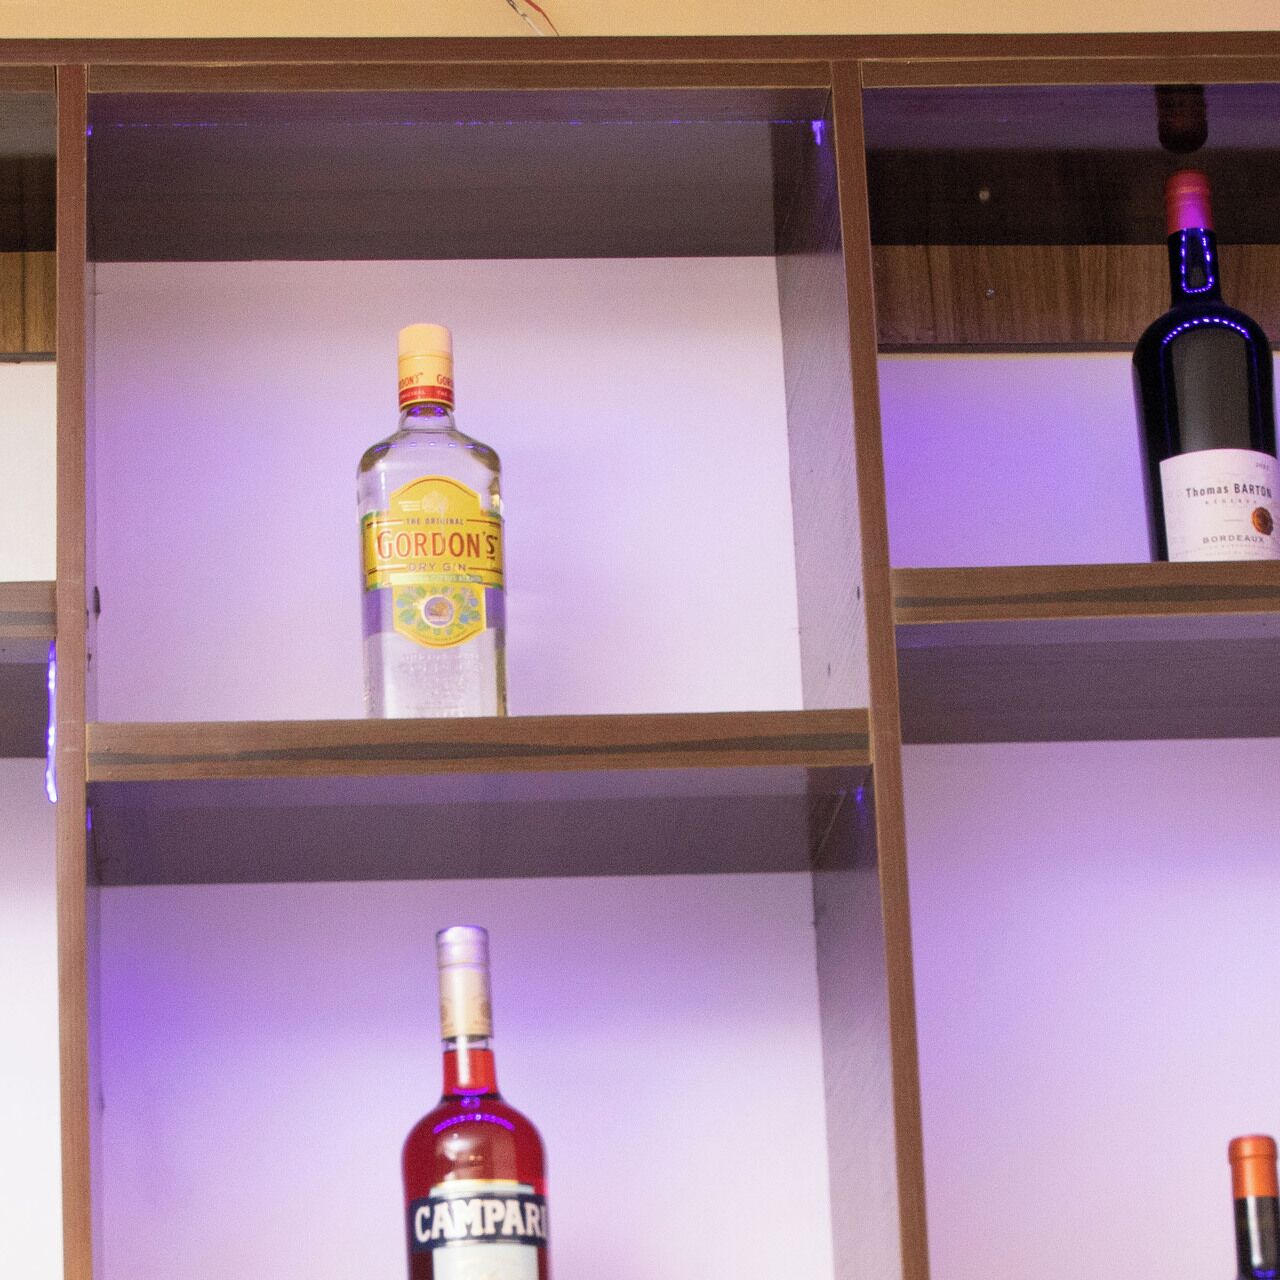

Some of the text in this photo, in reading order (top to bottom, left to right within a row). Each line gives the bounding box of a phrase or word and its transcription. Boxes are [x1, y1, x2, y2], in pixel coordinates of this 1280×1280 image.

[1186, 483, 1272, 498] Thomas BARTON
[376, 530, 498, 560] GORDON'S
[408, 562, 466, 571] DRY GIN
